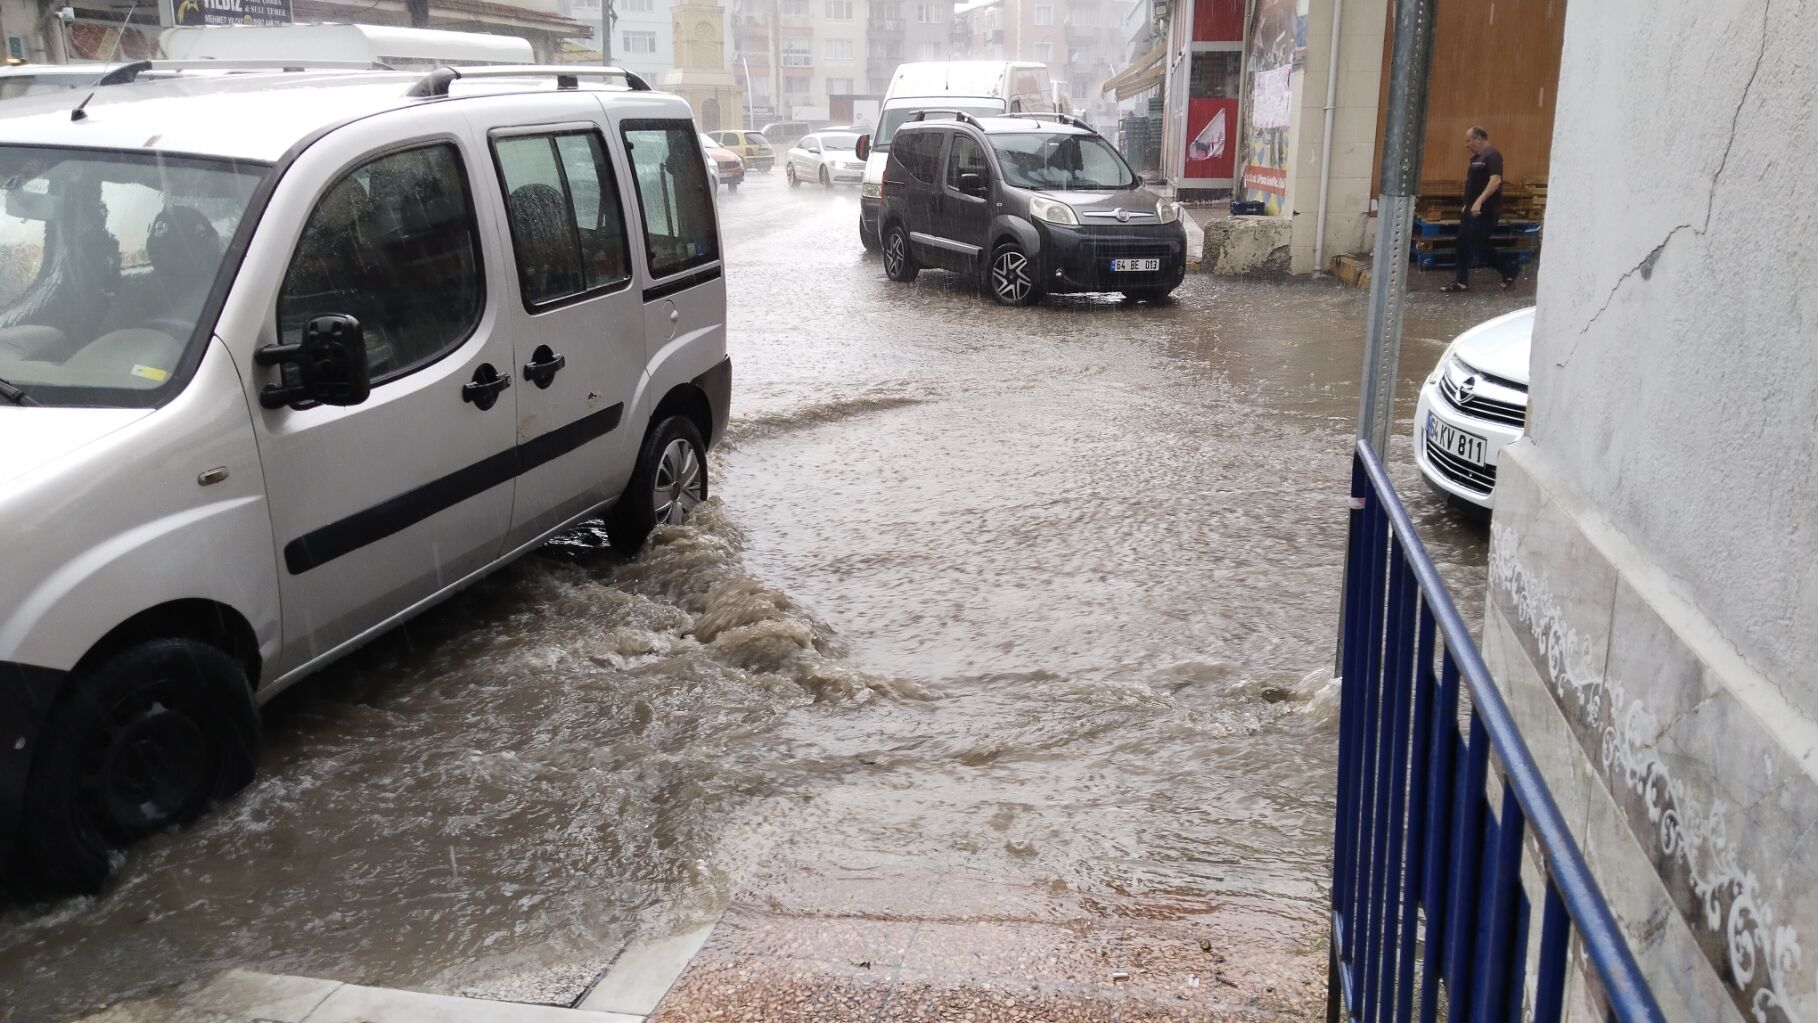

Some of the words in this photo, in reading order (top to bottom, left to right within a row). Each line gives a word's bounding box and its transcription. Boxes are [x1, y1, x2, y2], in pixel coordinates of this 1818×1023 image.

[1116, 260, 1126, 270] 64
[1131, 260, 1139, 270] BE
[1145, 260, 1157, 270] 013
[1439, 424, 1455, 450] KV
[1458, 434, 1482, 463] 811
